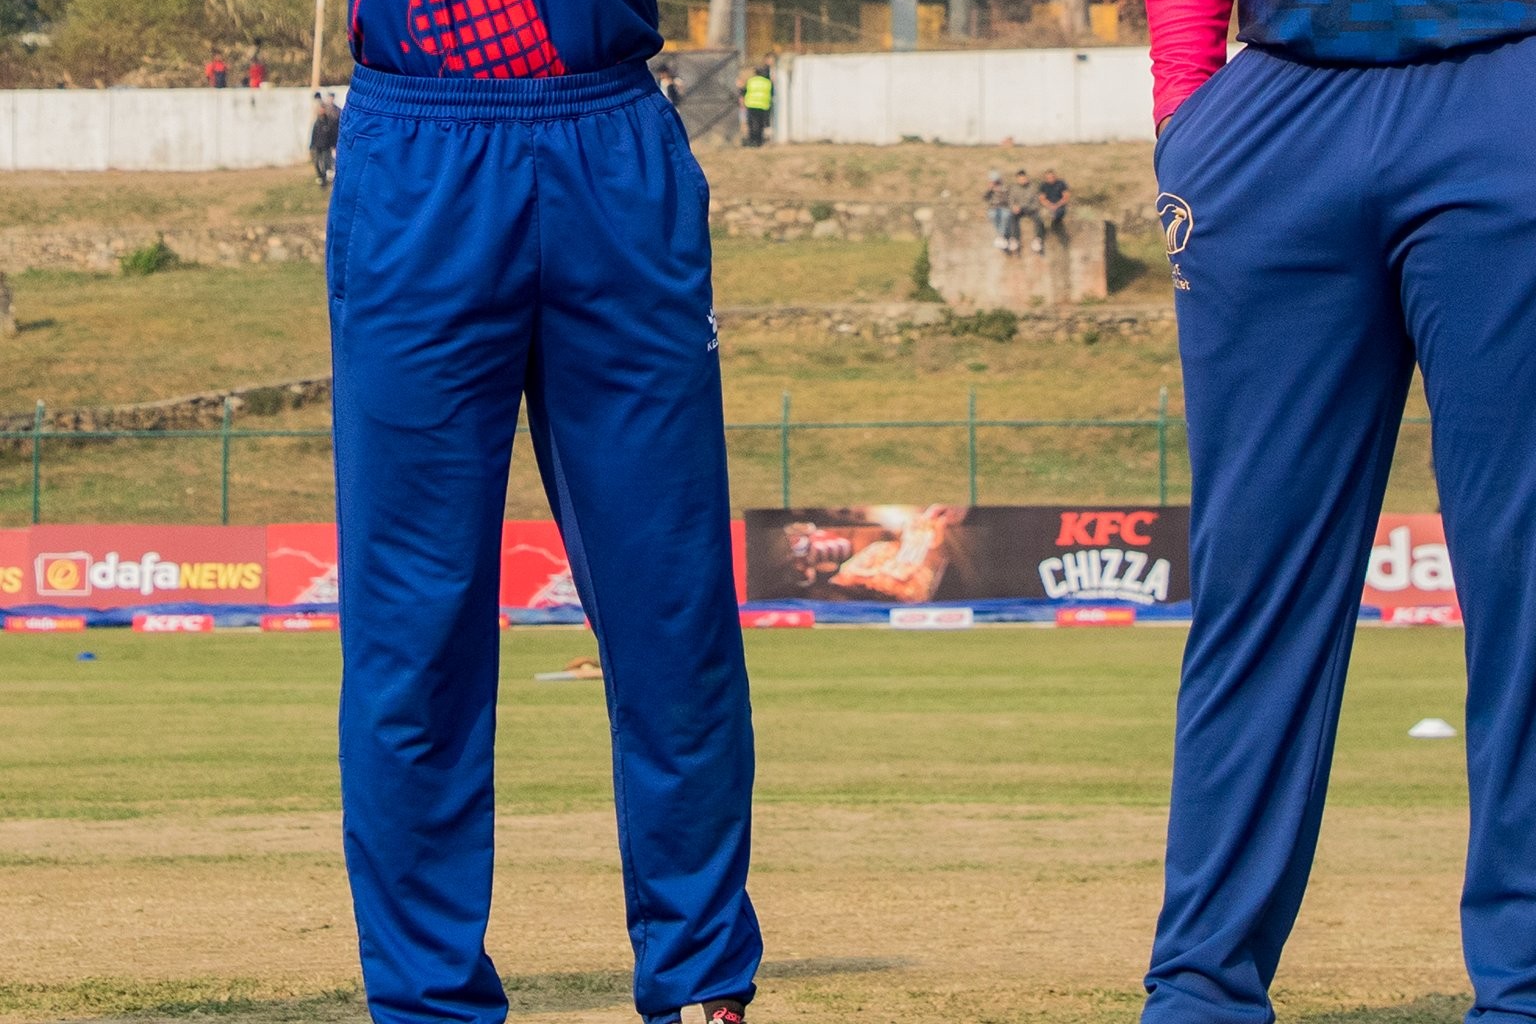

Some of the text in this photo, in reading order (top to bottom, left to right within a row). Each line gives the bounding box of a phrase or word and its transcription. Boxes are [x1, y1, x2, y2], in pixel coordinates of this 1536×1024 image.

[1055, 510, 1159, 546] KFC
[1038, 548, 1171, 602] CHIZZA
[142, 614, 207, 632] KFC
